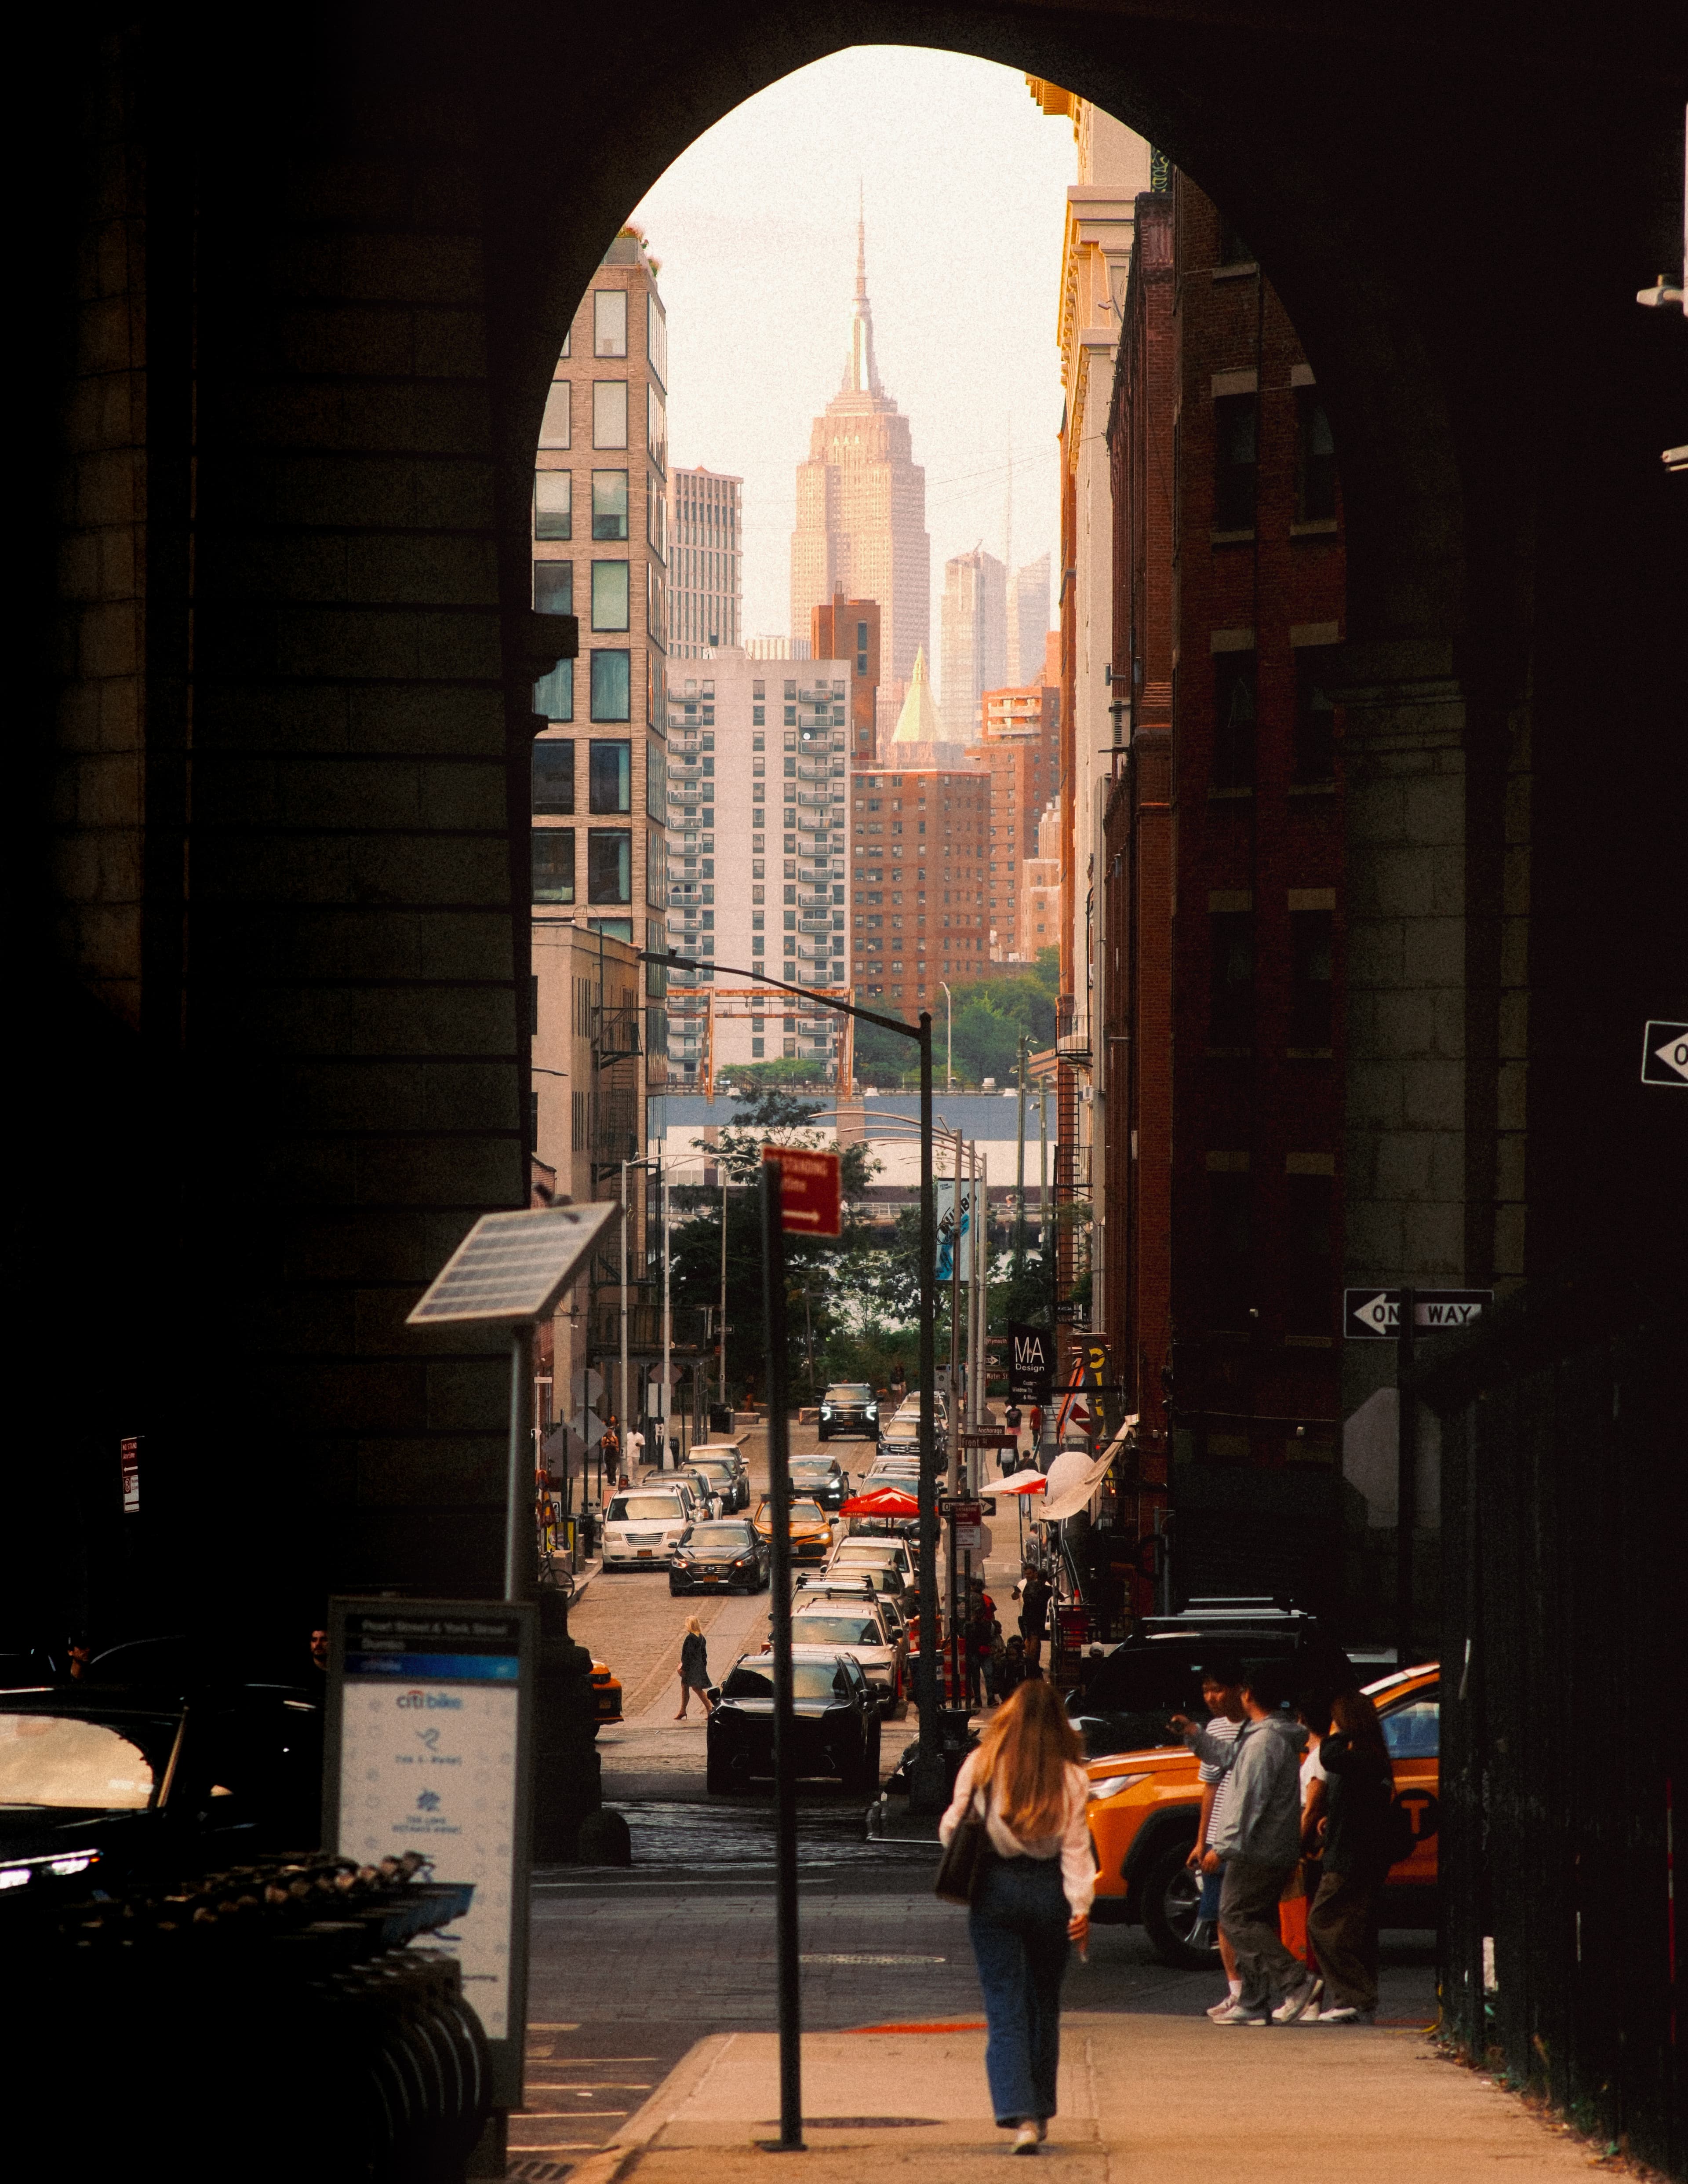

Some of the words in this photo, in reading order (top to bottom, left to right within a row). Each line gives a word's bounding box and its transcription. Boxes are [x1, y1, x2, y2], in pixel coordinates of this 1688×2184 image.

[1373, 1305, 1400, 1323] ON
[1429, 1305, 1472, 1323] WAY
[1015, 1363, 1044, 1373] Design
[962, 1437, 979, 1447] Front
[1400, 1799, 1429, 1834] T
